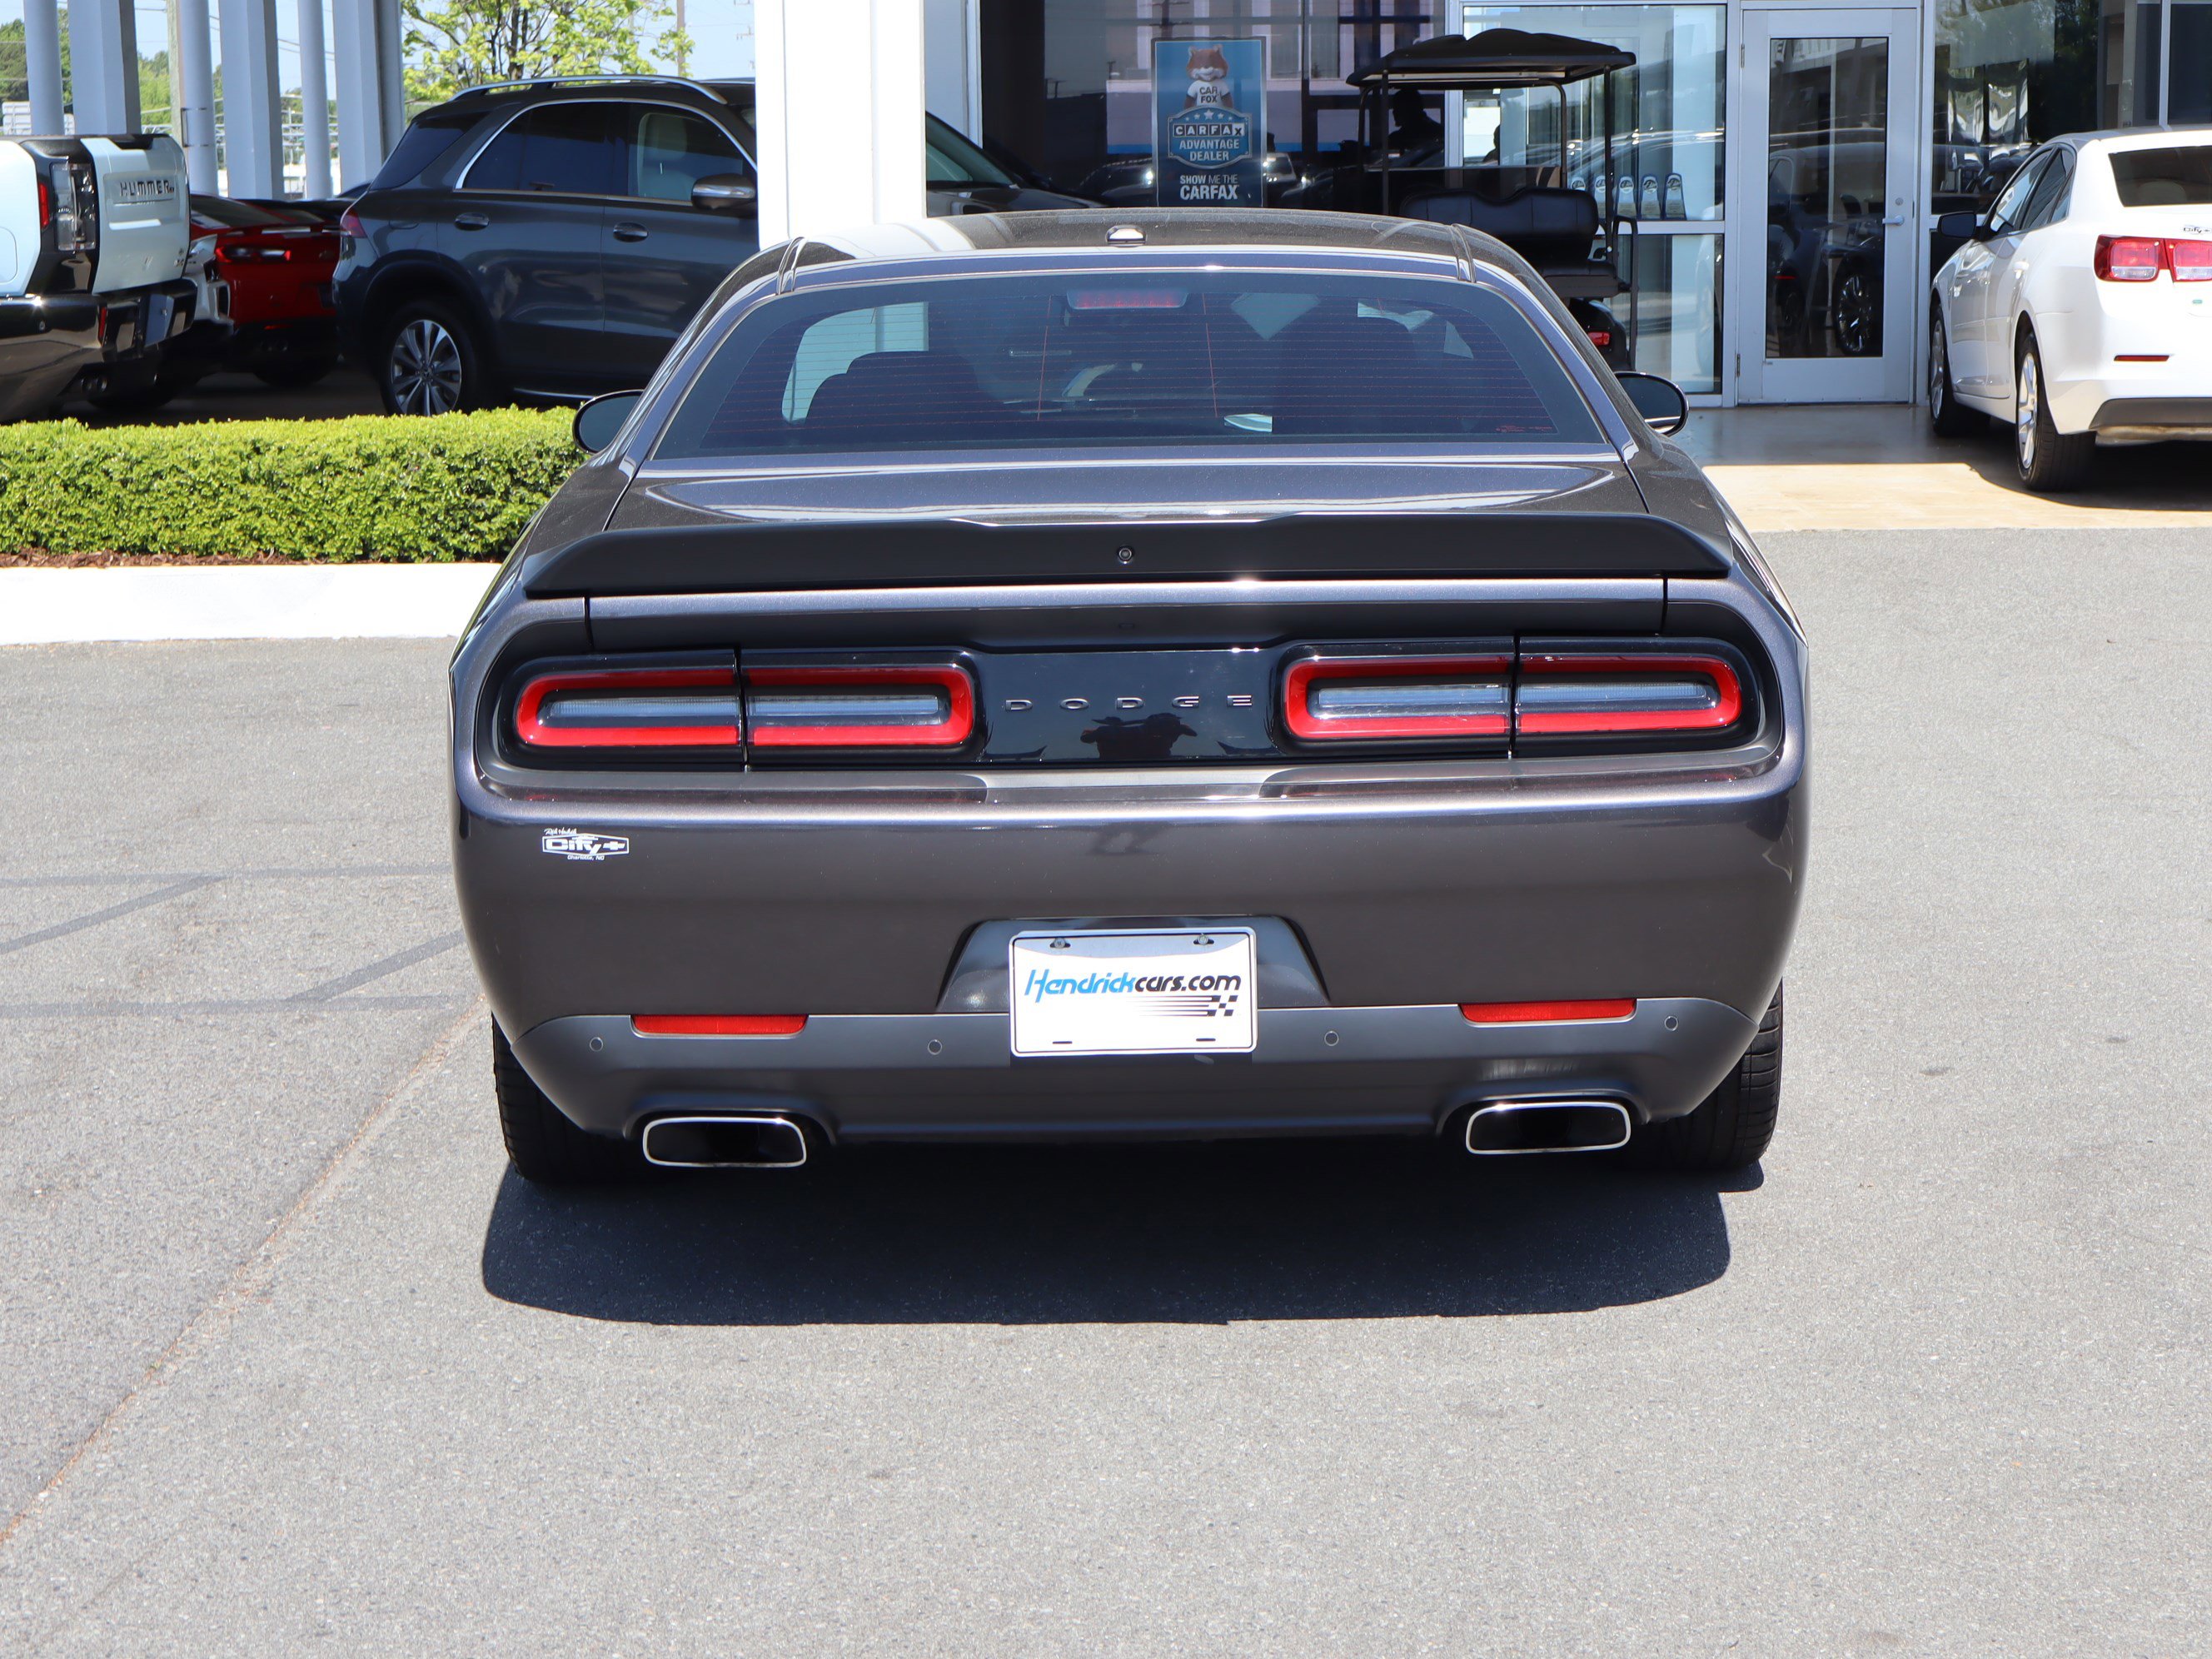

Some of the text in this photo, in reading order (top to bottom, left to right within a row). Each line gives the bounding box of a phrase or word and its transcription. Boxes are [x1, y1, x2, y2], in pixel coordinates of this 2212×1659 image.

[1199, 86, 1218, 95] CAR
[1200, 95, 1218, 104] FOX
[1173, 124, 1244, 137] CARFAX
[1179, 139, 1240, 150] ADVANTAGE
[1189, 151, 1229, 162] DEALER
[1179, 174, 1238, 185] SHOW ME THE
[120, 180, 170, 197] HUMMER
[1179, 185, 1238, 201] CARFAX
[1005, 695, 1253, 711] DODGE
[546, 835, 601, 854] City
[1024, 969, 1242, 1004] Hendrickcars.com
